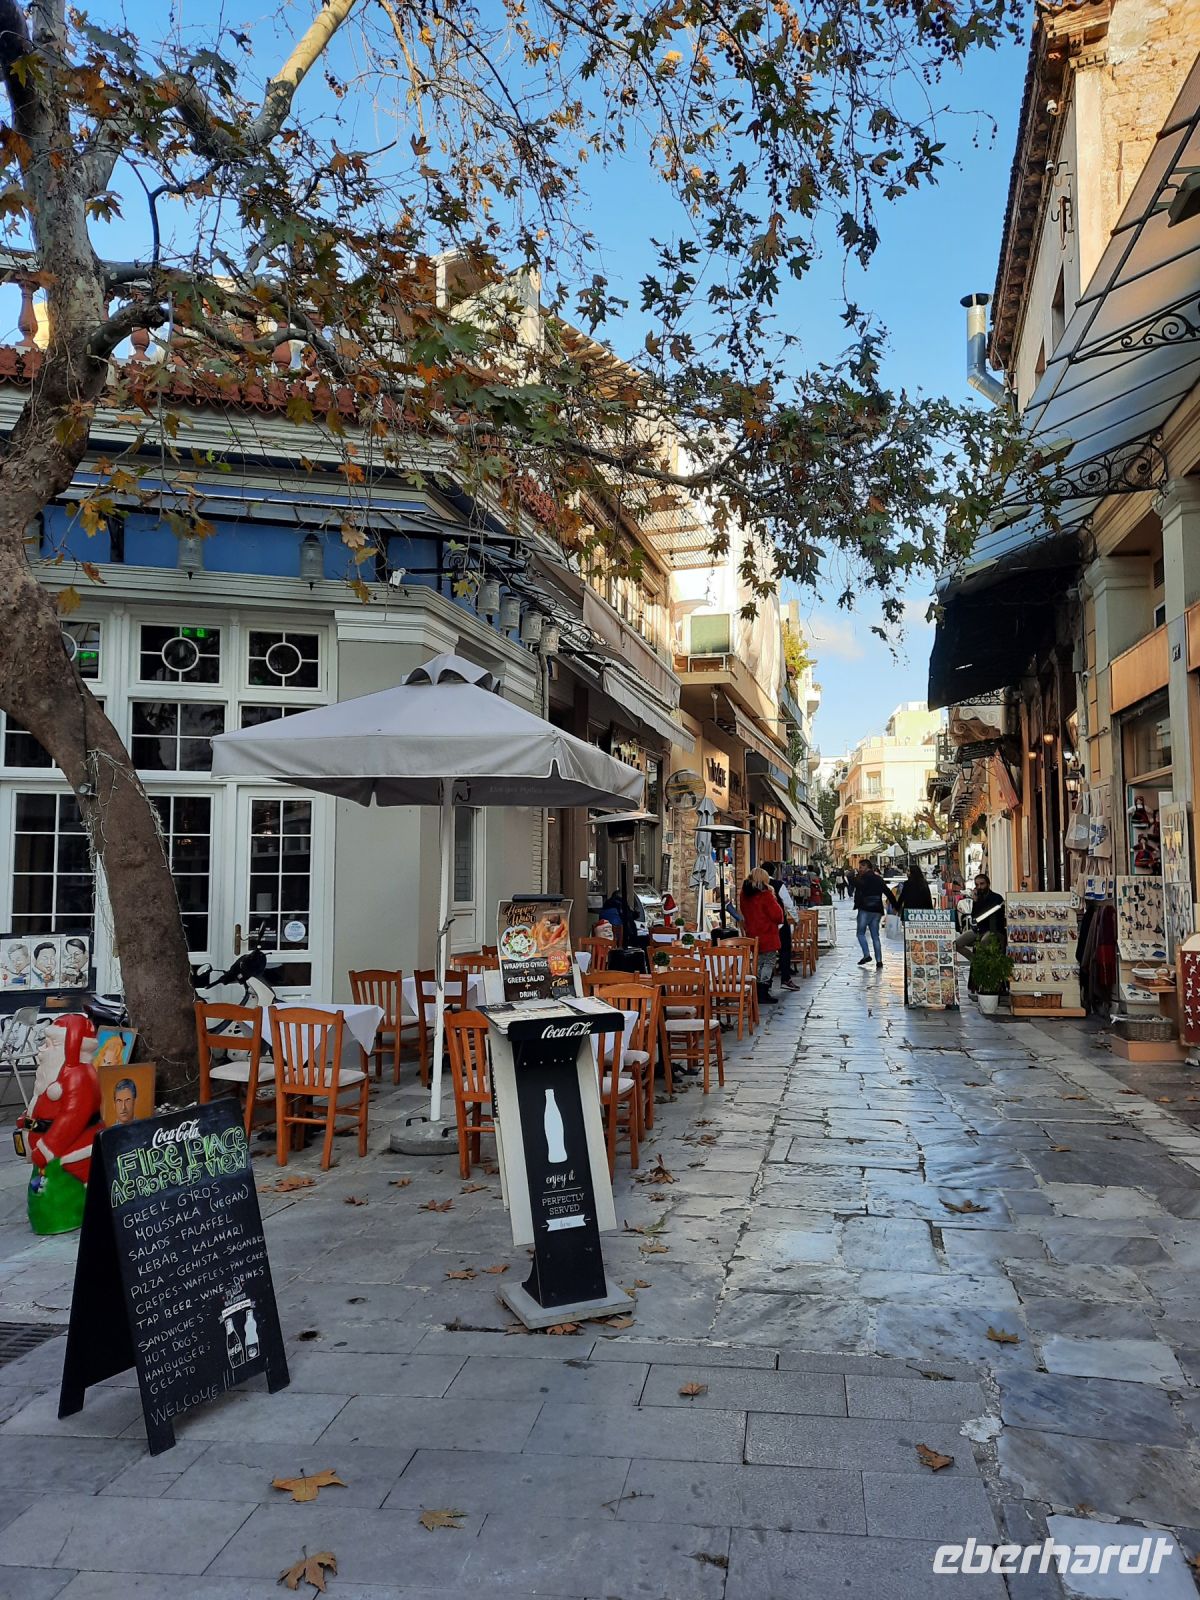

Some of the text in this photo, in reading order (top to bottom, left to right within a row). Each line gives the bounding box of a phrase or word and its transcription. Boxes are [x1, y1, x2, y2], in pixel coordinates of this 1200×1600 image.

[503, 962, 530, 970] WRAPPED
[507, 976, 526, 984] GREEK
[519, 990, 538, 998] DRINK
[152, 1119, 200, 1148] Coca-Cola
[111, 1162, 203, 1208] ACROPOLIS
[546, 1173, 567, 1189] enjoy
[123, 1182, 220, 1229] GREEK GYROS
[135, 1184, 249, 1241] MOUSSAKA (VEGAN)
[541, 1193, 584, 1206] PERFECTLY
[549, 1204, 580, 1215] SERVED
[128, 1236, 170, 1261] SALADS
[137, 1224, 244, 1276] KEBAB KALAMARI
[130, 1276, 164, 1300] PIZZA
[177, 1252, 219, 1277] GEMISTA
[136, 1313, 159, 1330] TAP
[164, 1299, 193, 1319] BEER
[144, 1348, 167, 1366] HOT
[150, 1366, 196, 1395] GELATO
[150, 1383, 218, 1426] WELCOME
